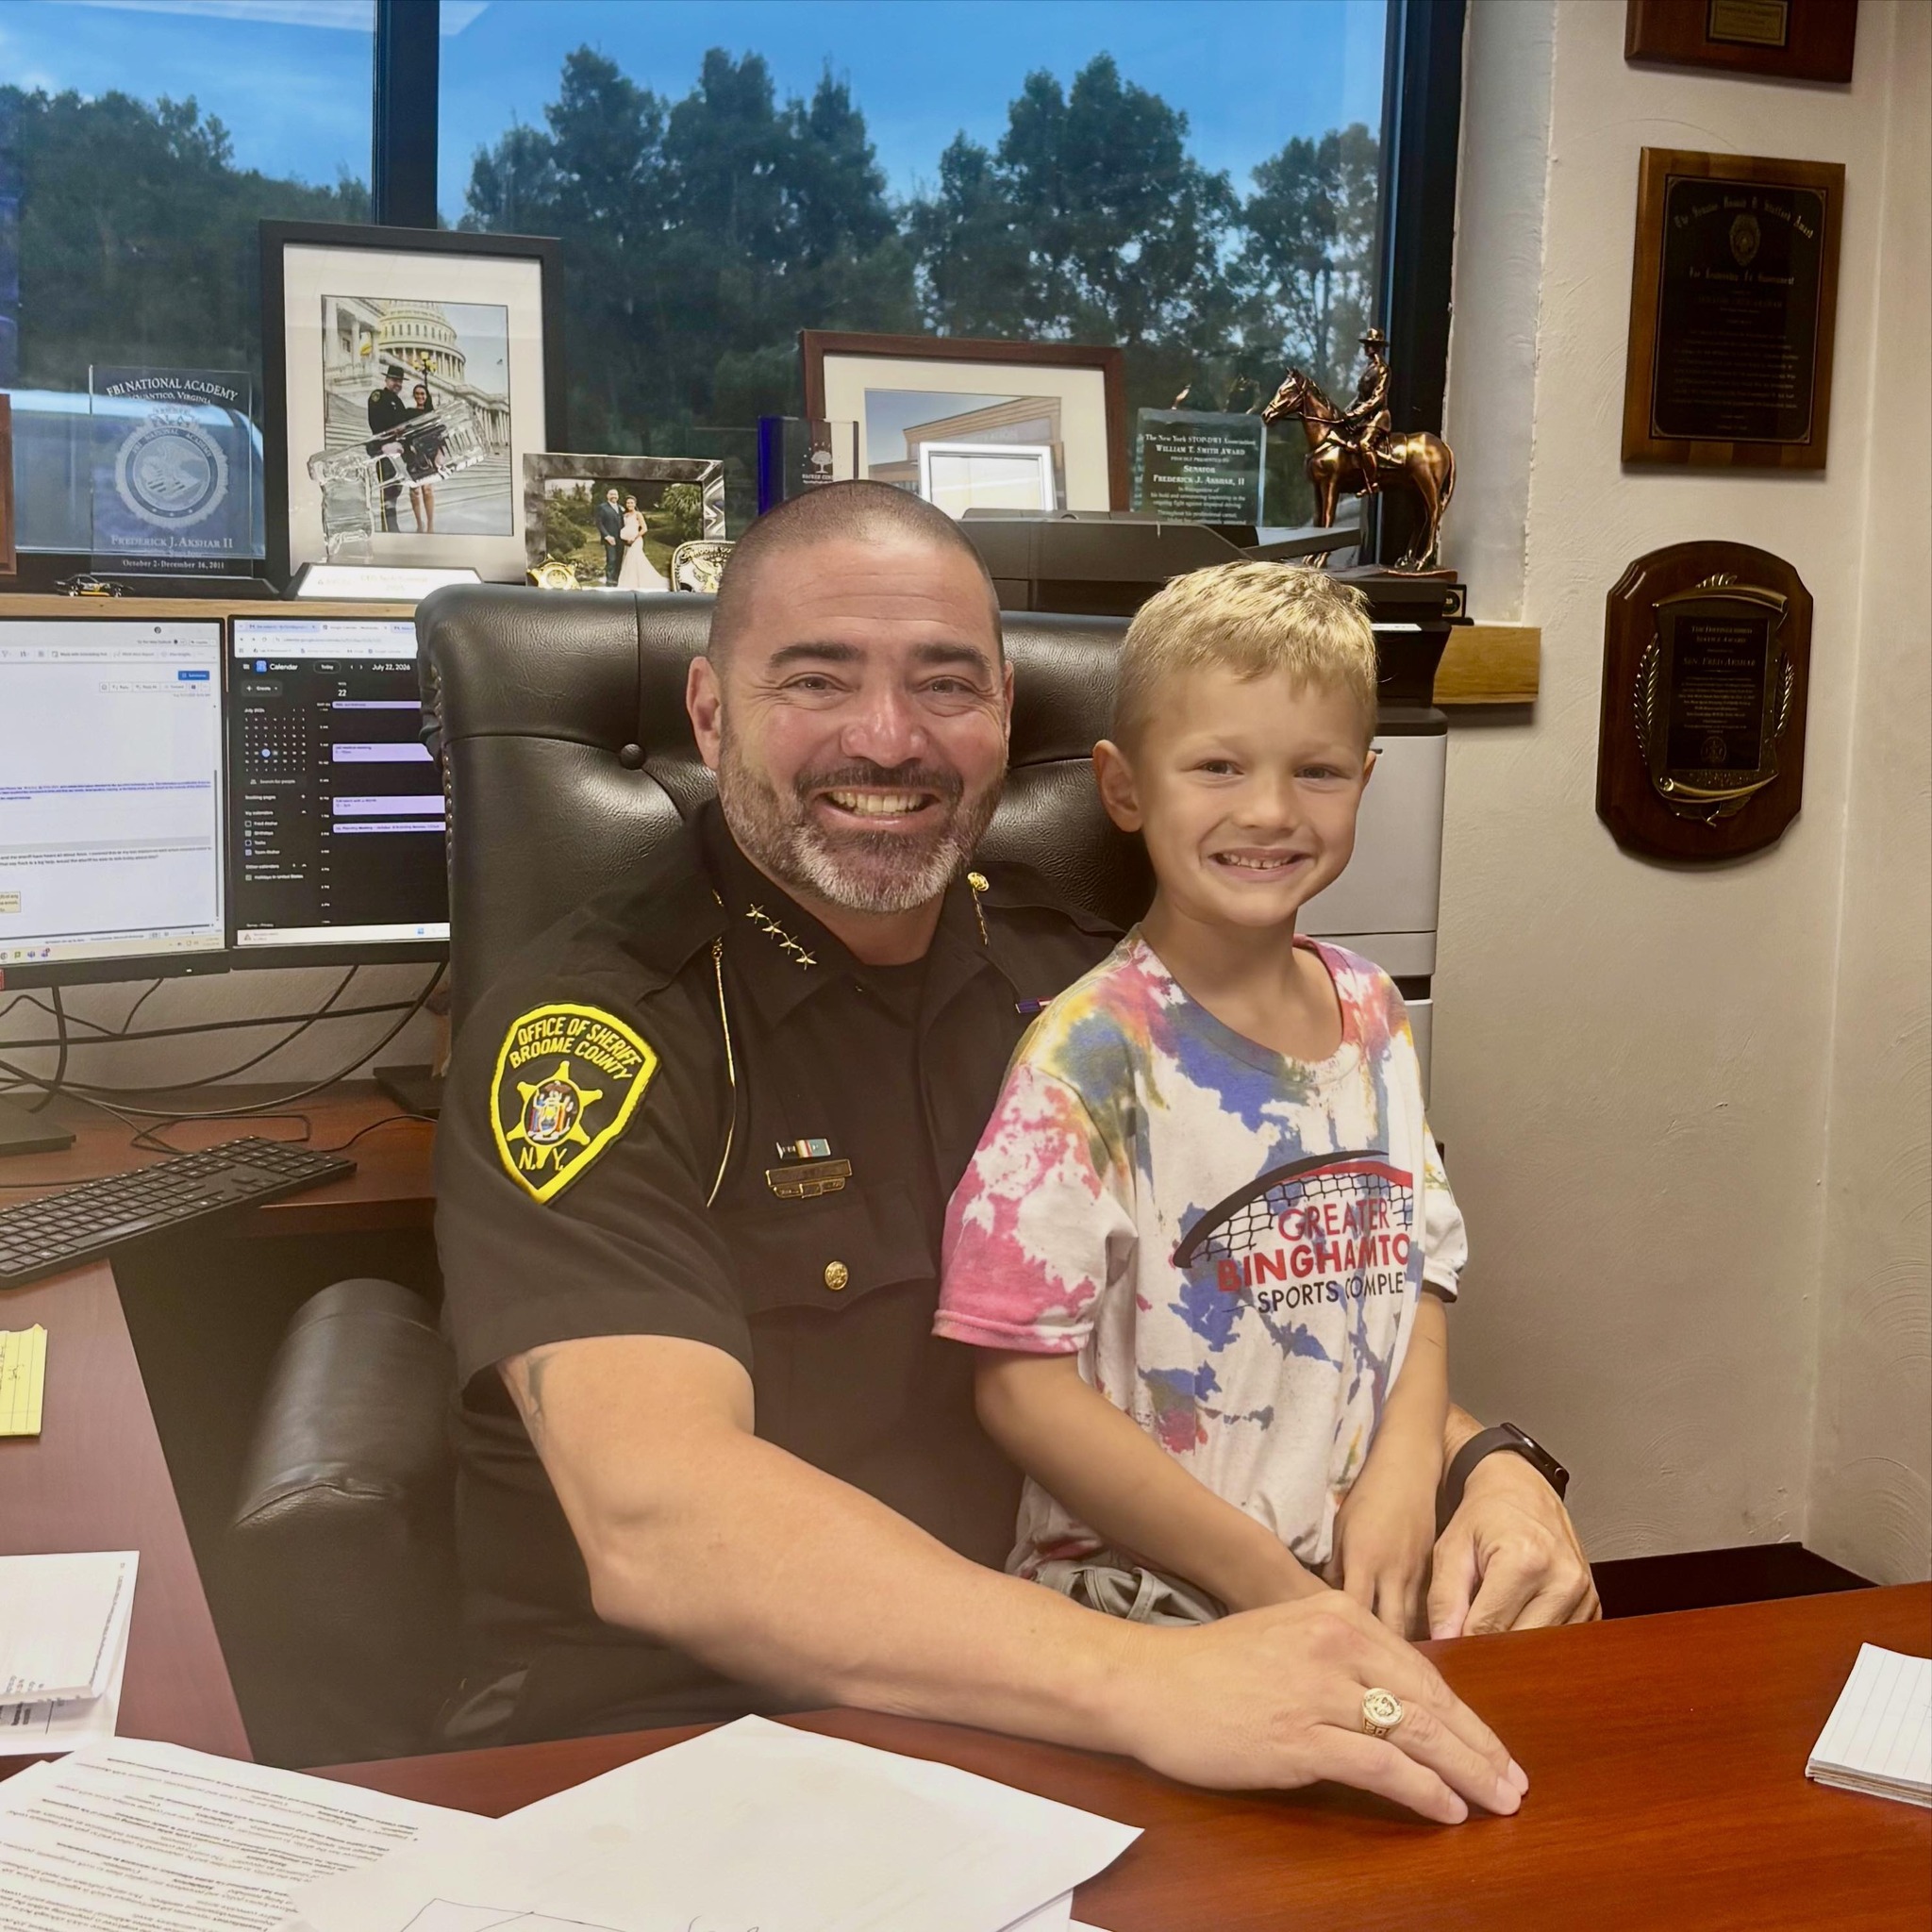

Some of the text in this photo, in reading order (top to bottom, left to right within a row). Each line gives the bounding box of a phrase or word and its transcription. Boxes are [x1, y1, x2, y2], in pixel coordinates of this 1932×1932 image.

[106, 377, 240, 402] FBI NATIONAL ACADEMY
[110, 534, 234, 549] FREDERICK J. AKSHAR II
[123, 558, 151, 567] October
[269, 662, 298, 671] Calendar
[372, 663, 384, 673] July
[338, 689, 347, 697] 22
[517, 1016, 642, 1066] OFFICE OF SHERIFF
[508, 1037, 633, 1080] BROOME COUNTY
[518, 1146, 537, 1171] N.
[1278, 1197, 1391, 1241] GREATER
[1257, 1270, 1407, 1314] SPORTS COMPLE
